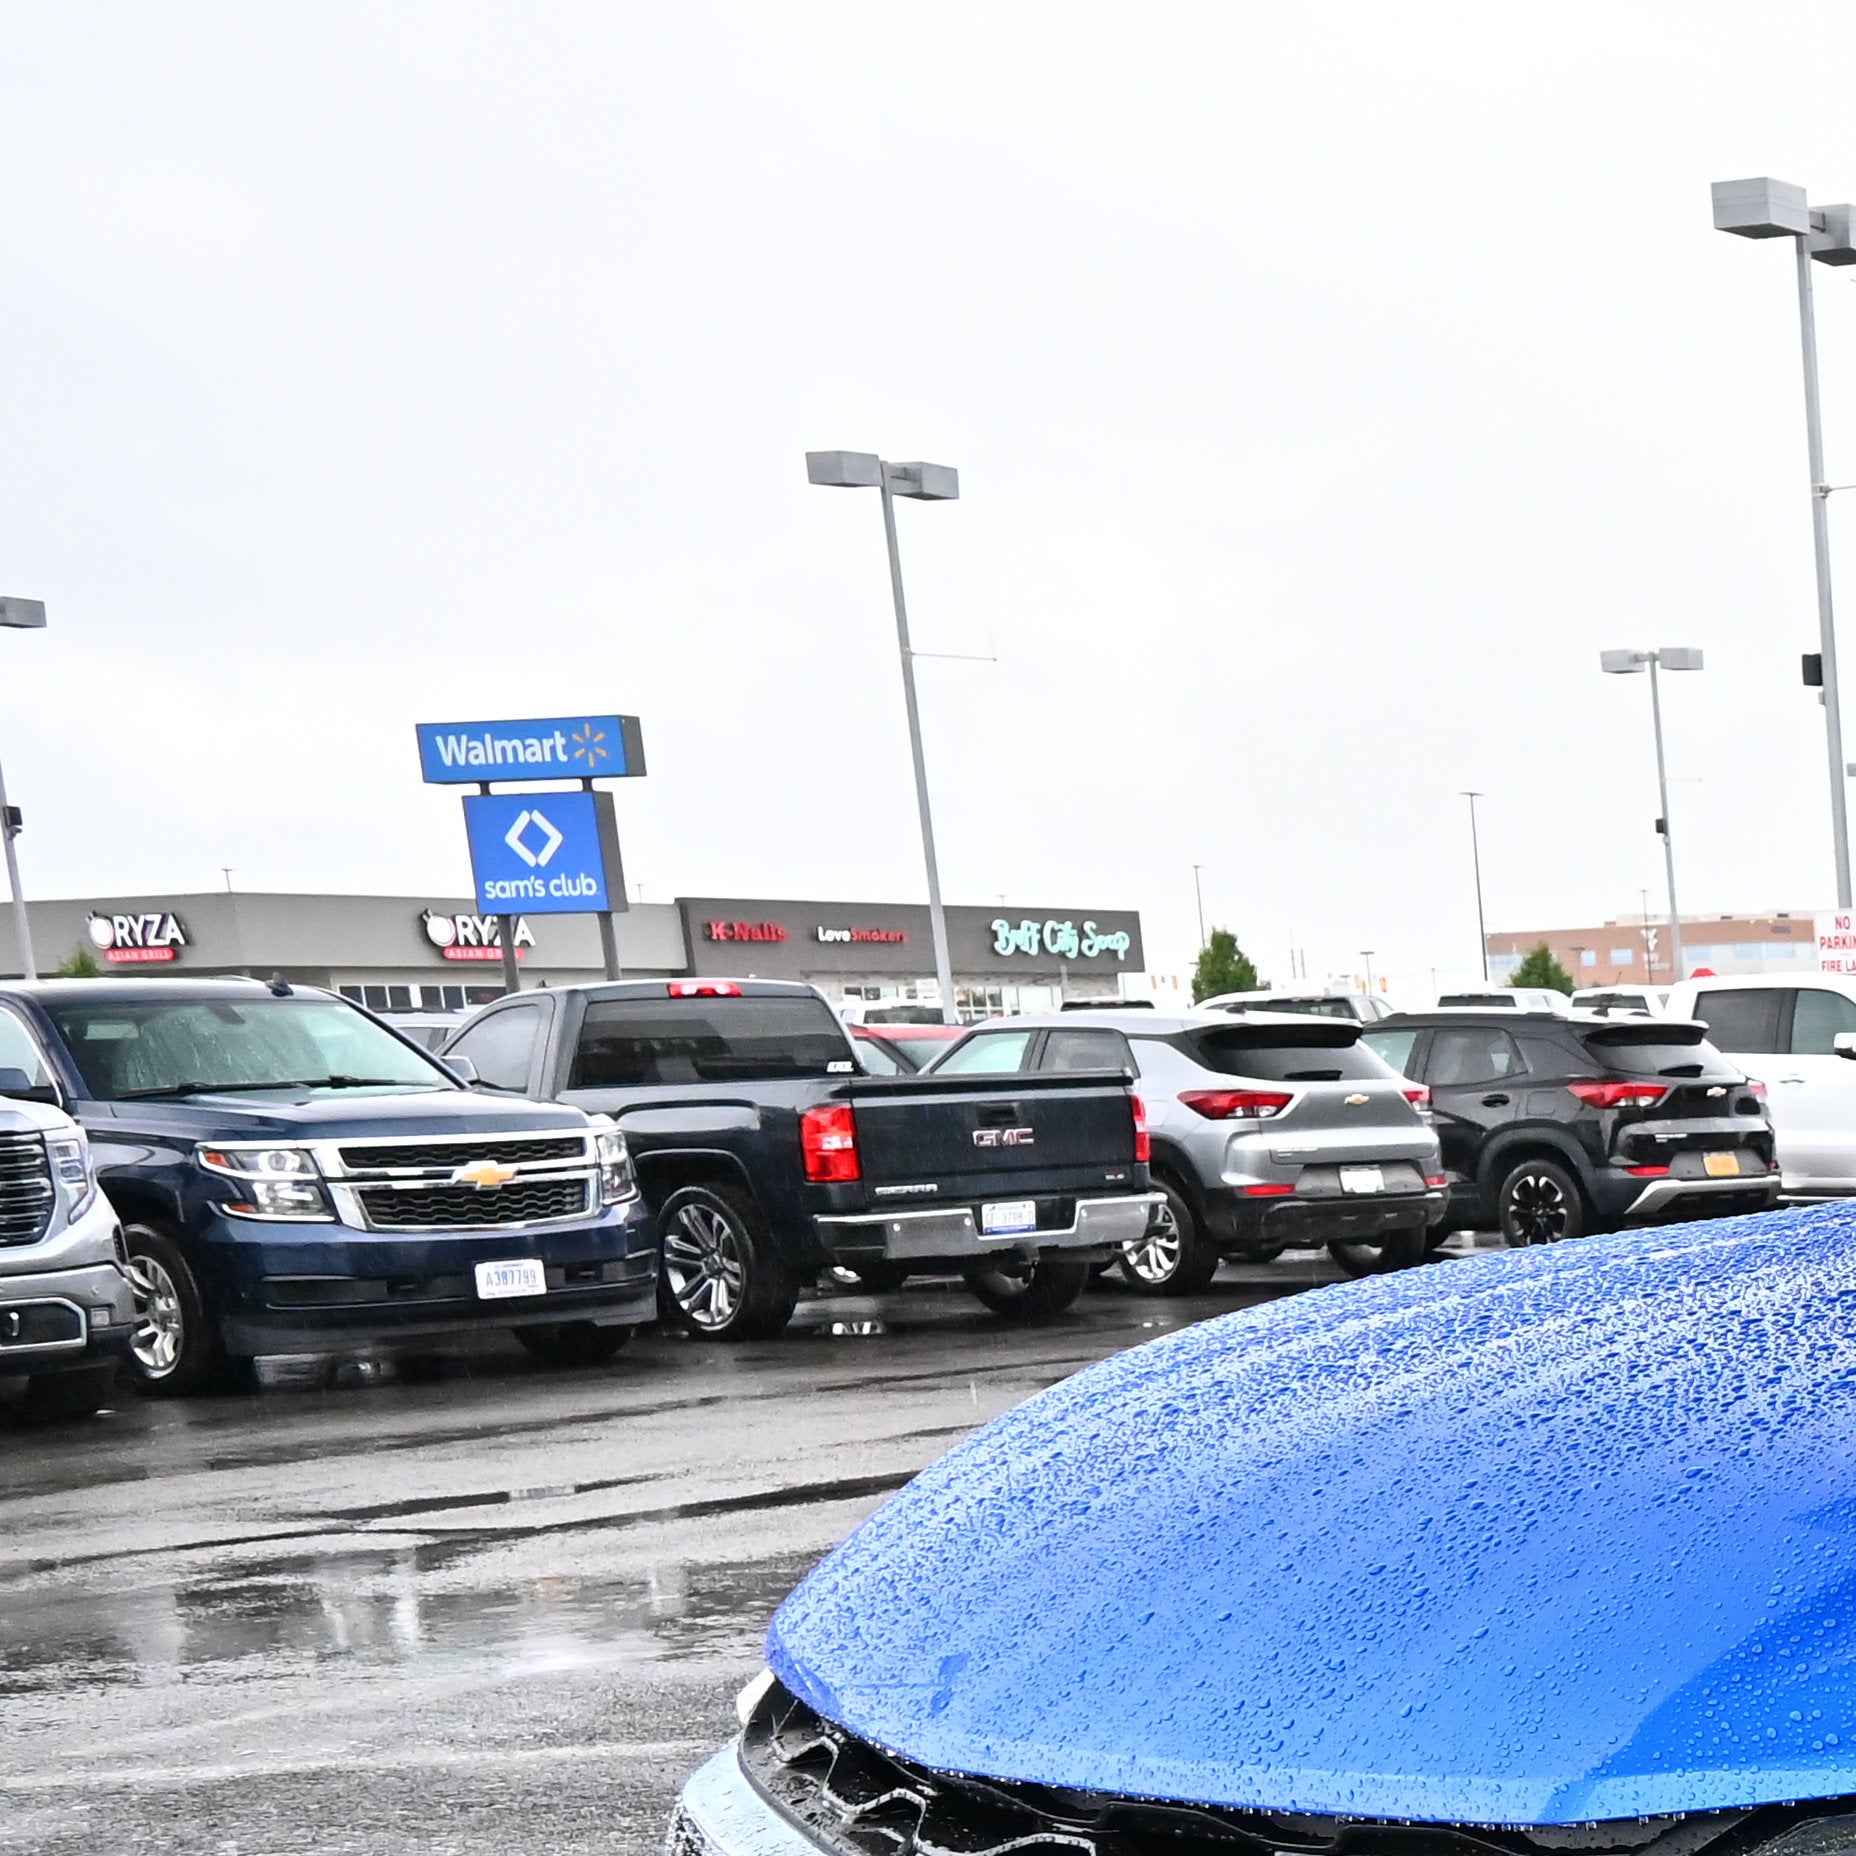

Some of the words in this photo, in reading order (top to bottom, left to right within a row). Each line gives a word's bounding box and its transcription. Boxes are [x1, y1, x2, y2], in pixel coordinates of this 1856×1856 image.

[435, 730, 569, 767] Walmart
[484, 875, 546, 899] sam's
[549, 872, 599, 896] club
[1834, 915, 1851, 930] NO
[1081, 920, 1130, 961] Soap
[1821, 959, 1842, 972] FIRE
[972, 1127, 1034, 1147] GMC
